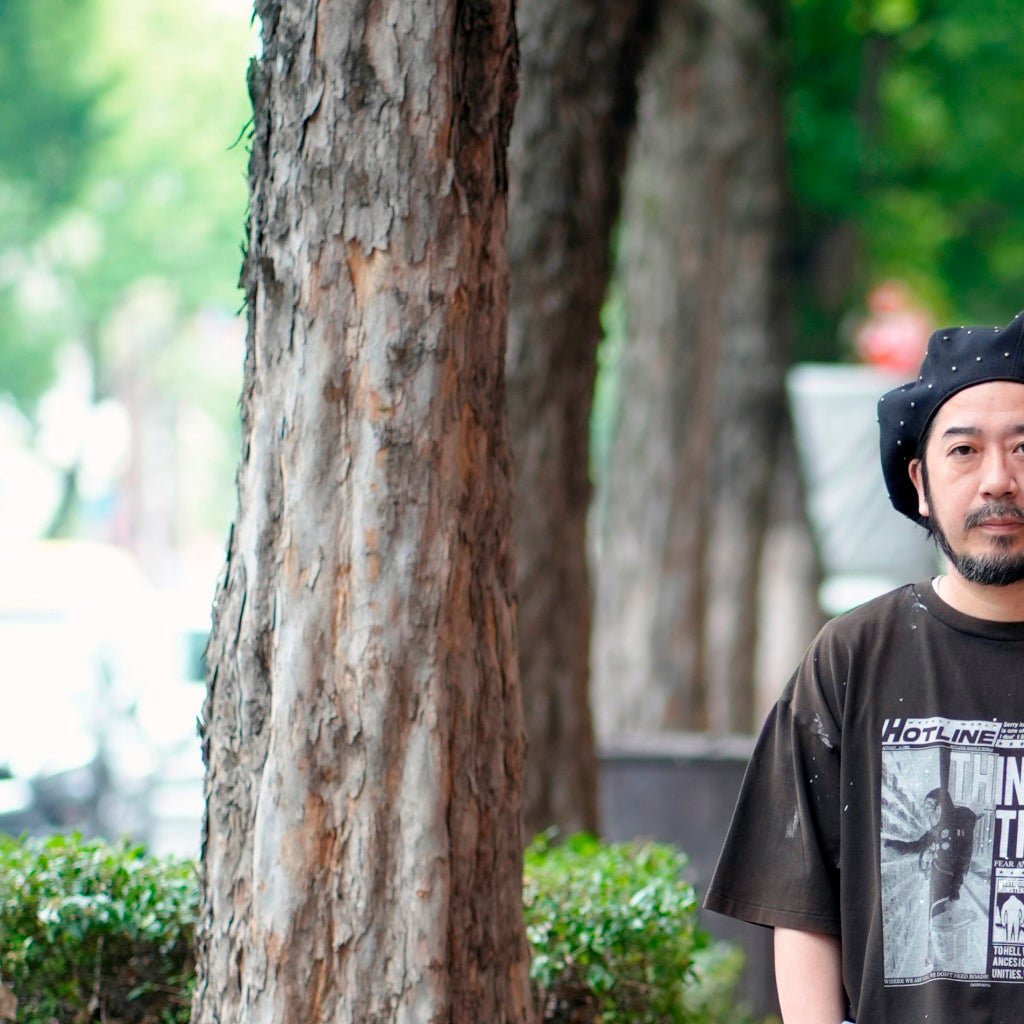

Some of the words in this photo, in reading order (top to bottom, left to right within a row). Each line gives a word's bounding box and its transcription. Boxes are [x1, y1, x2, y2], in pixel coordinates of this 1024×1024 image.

[883, 719, 996, 744] HOTLINE
[994, 860, 1014, 868] FEAR
[993, 946, 1003, 955] TO
[1003, 946, 1021, 956] HELL
[992, 957, 1017, 967] ANCES
